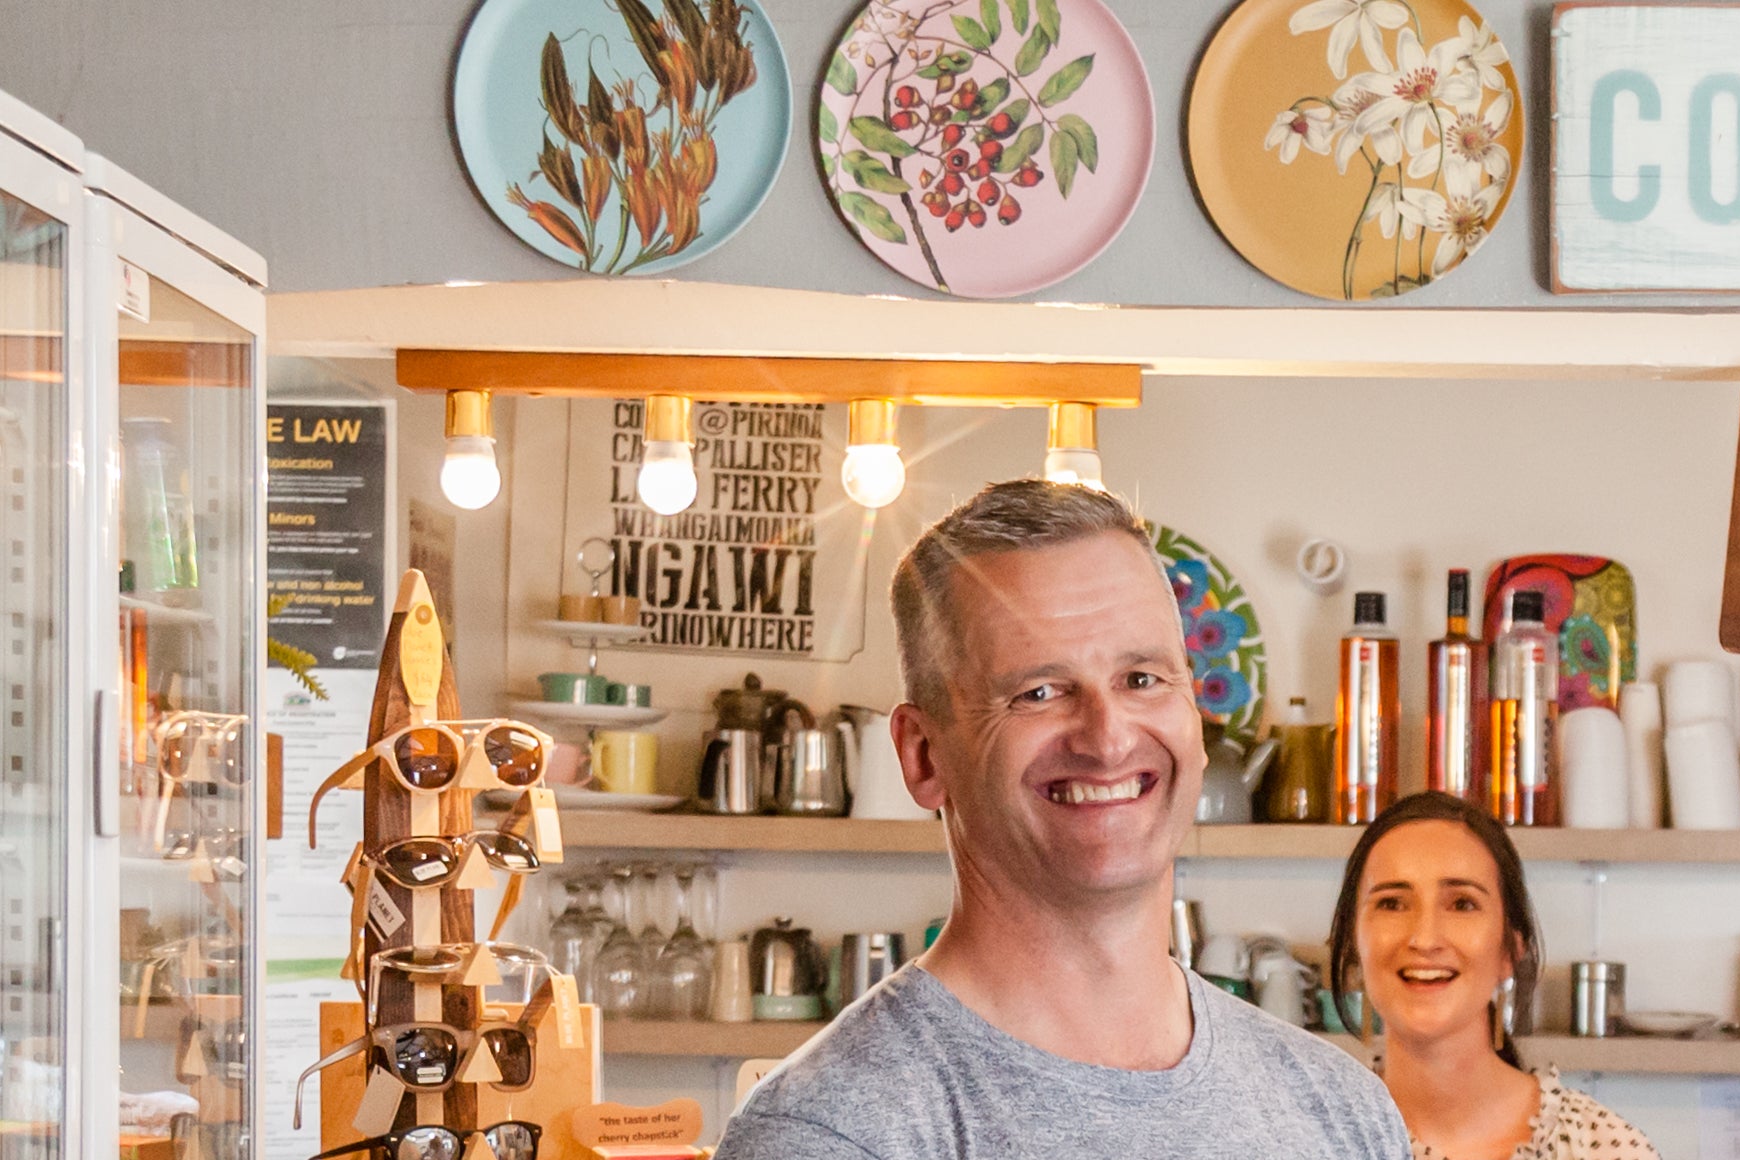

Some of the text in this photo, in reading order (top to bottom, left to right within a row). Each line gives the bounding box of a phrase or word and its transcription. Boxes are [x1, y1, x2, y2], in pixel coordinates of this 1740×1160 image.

[293, 418, 362, 443] LAW
[712, 472, 822, 514] FERRY
[268, 513, 316, 525] Minors
[610, 538, 817, 617] NGAWI
[371, 892, 396, 924] PLANET
[623, 1115, 648, 1125] taste
[651, 1114, 661, 1123] of
[664, 1113, 681, 1121] her
[598, 1134, 630, 1143] cherry
